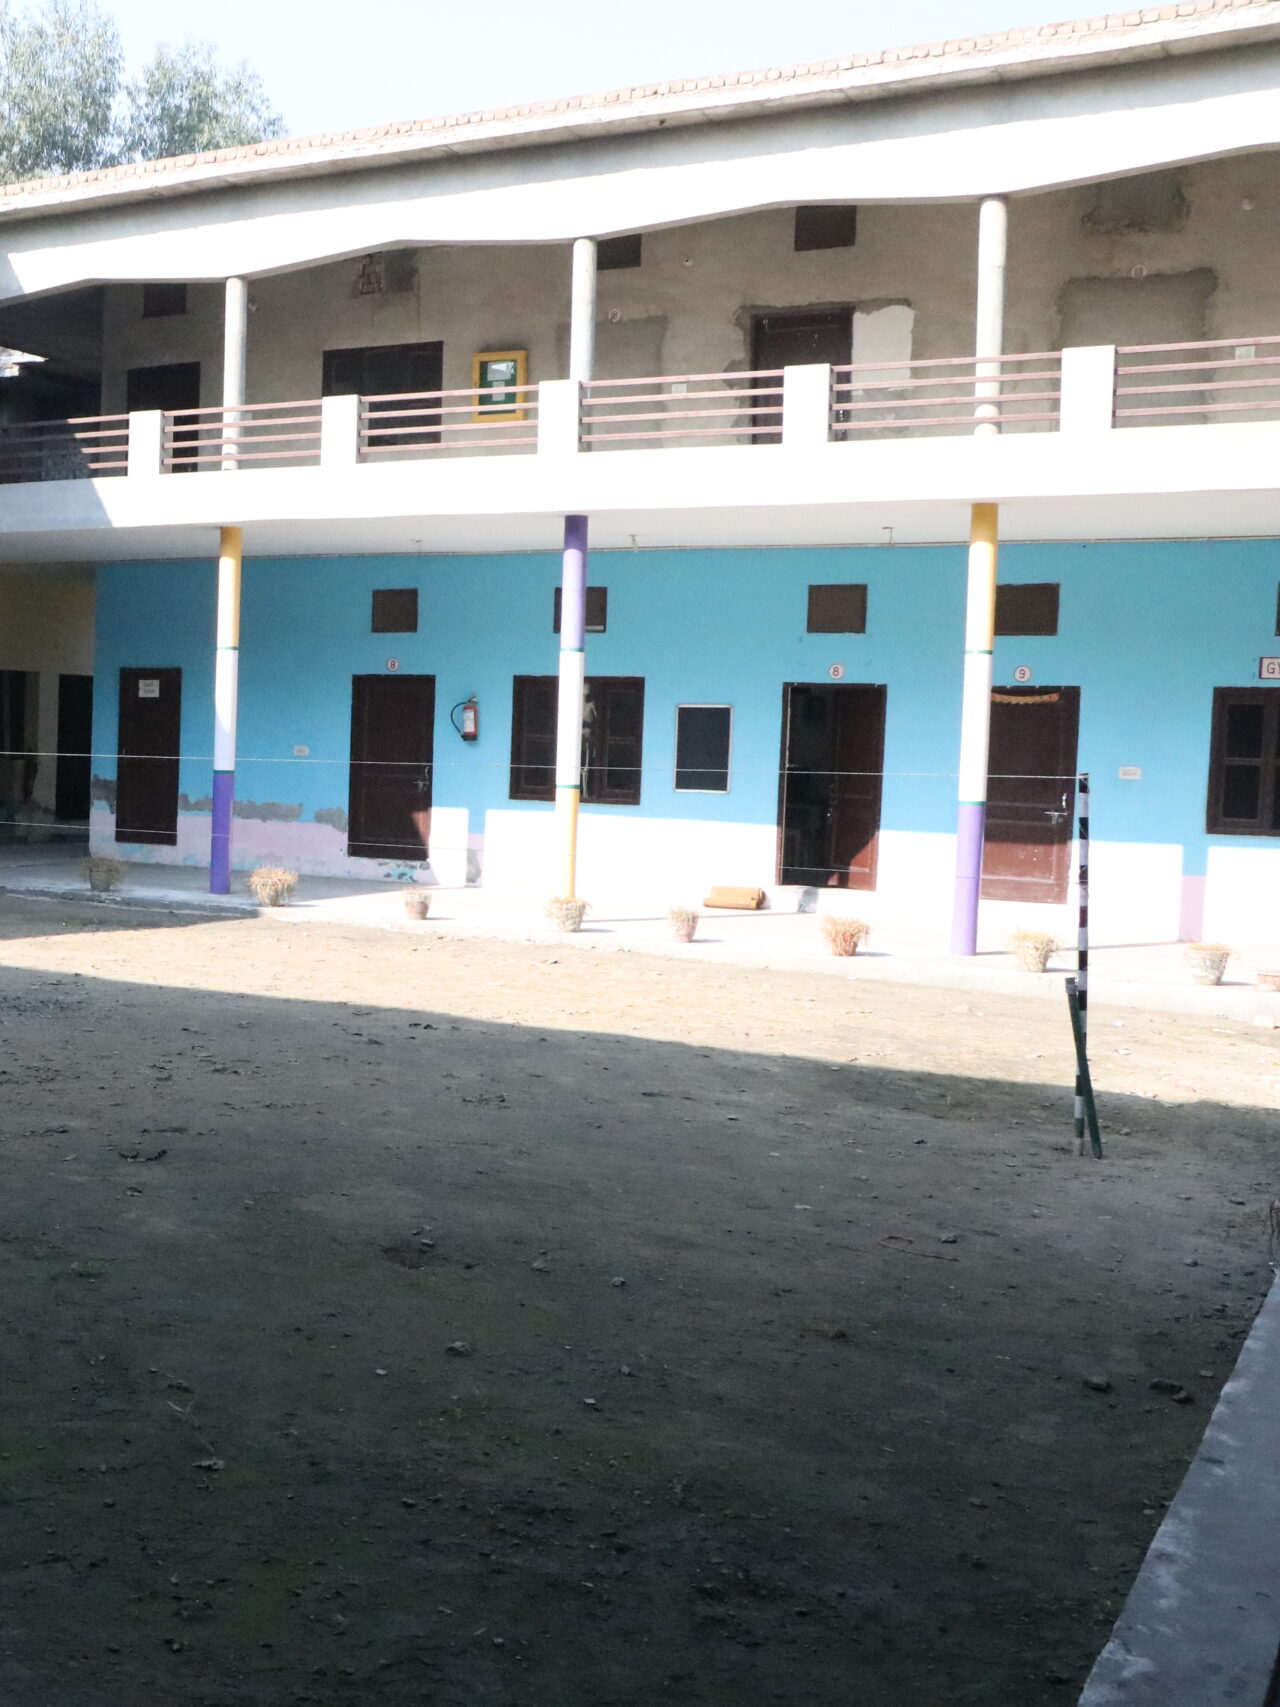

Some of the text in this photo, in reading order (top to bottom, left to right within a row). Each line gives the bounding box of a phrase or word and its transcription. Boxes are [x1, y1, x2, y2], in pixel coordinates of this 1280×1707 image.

[390, 660, 396, 669] 8
[832, 666, 839, 677] 8
[1018, 668, 1026, 679] 9
